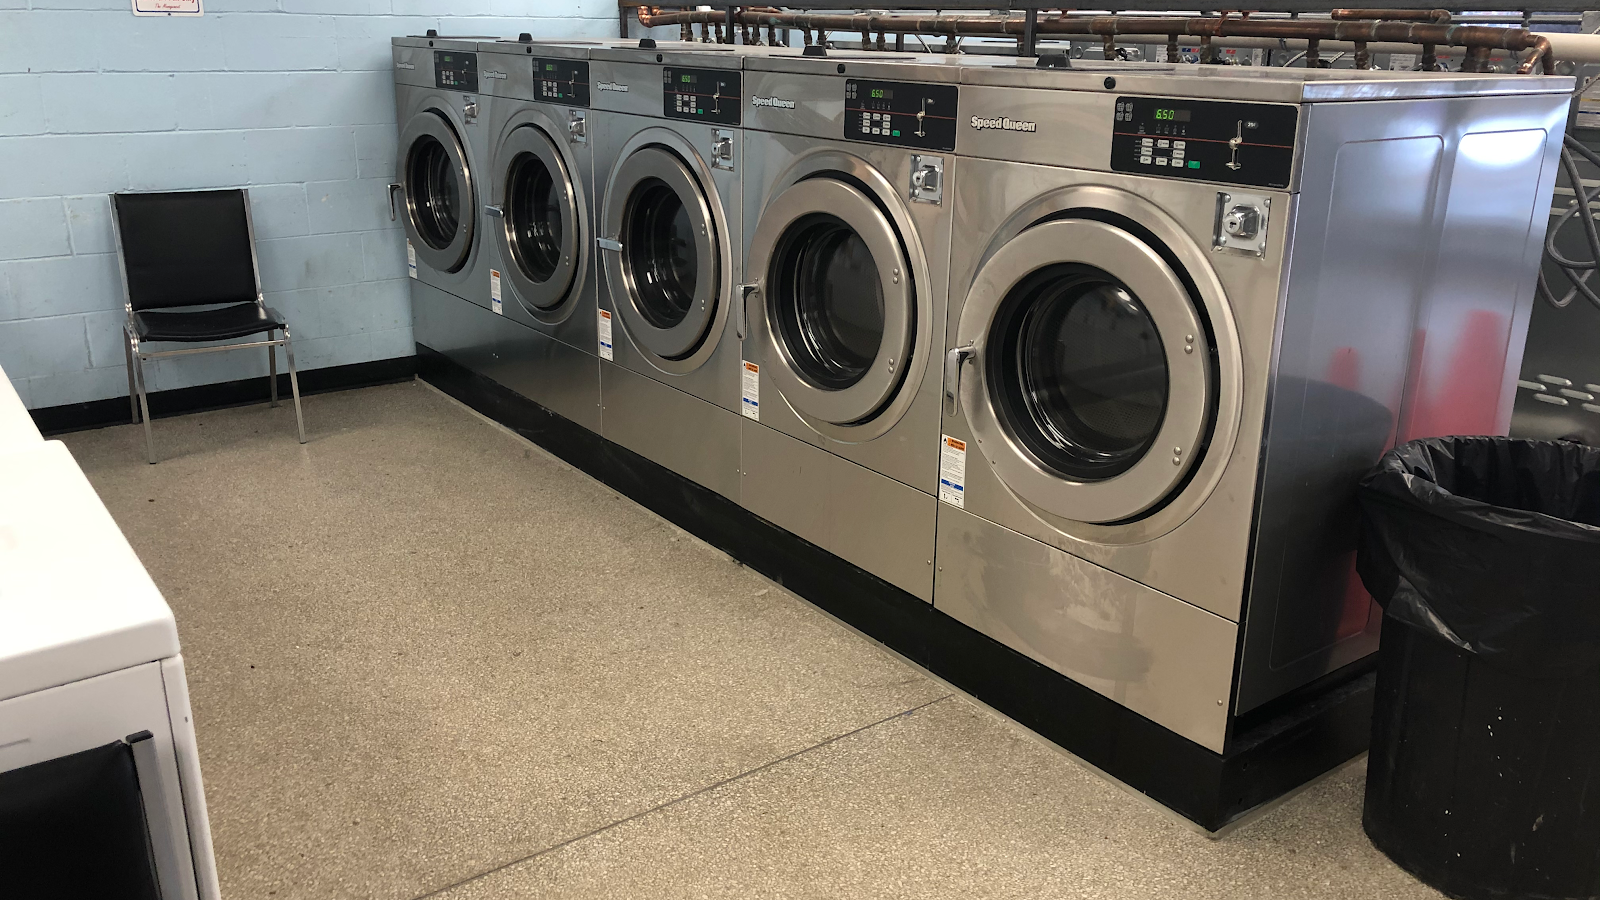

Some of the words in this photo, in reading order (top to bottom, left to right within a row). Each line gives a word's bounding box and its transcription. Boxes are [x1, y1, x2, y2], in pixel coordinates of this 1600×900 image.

[752, 95, 773, 107] Speed
[772, 97, 795, 109] Queen
[971, 115, 1002, 130] Speed
[1002, 117, 1036, 132] Queen
